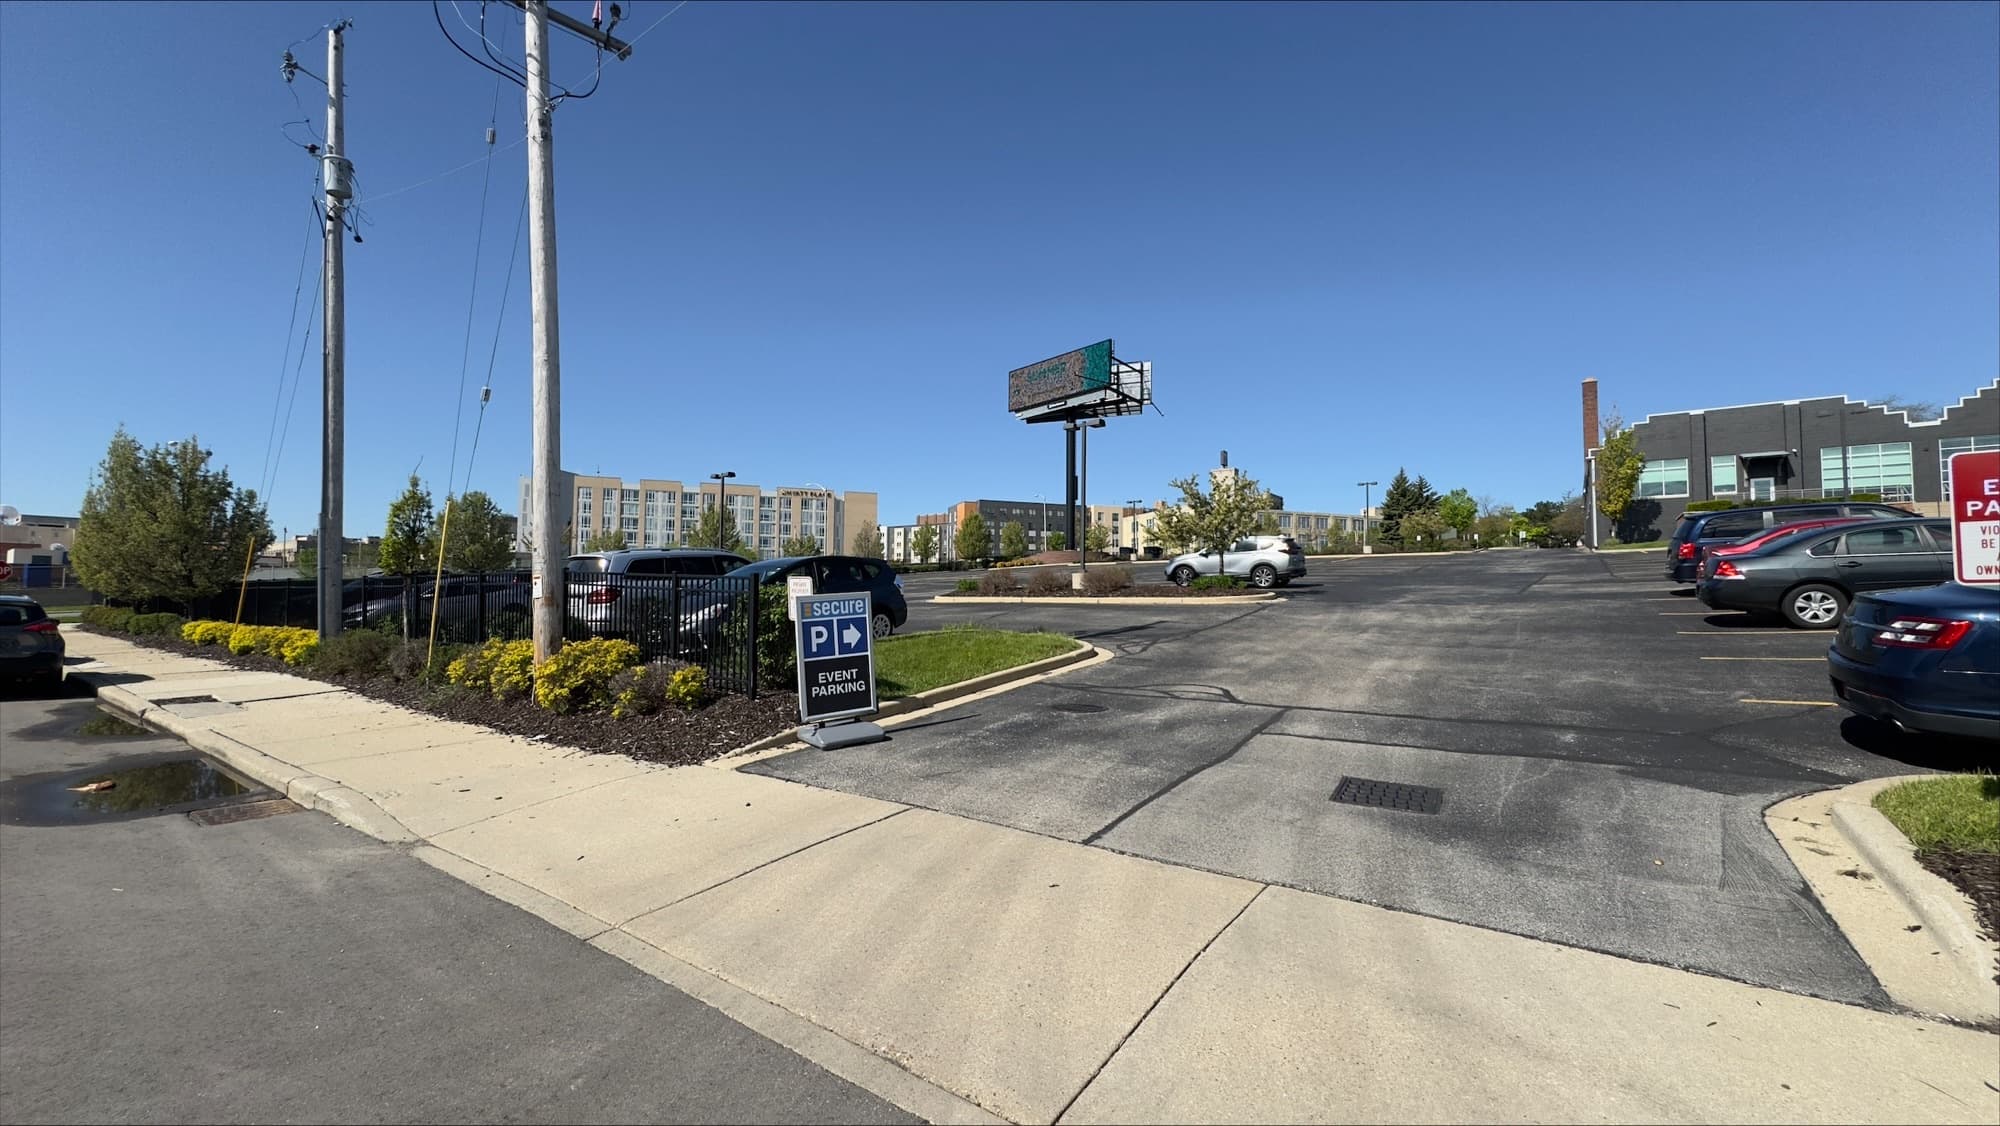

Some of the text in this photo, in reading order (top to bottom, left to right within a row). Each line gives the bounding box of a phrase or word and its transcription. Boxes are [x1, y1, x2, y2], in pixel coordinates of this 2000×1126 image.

[1981, 539, 1996, 549] BE
[813, 600, 864, 616] secure
[810, 626, 828, 653] P
[818, 669, 859, 684] EVENT
[811, 680, 866, 698] PARKING
